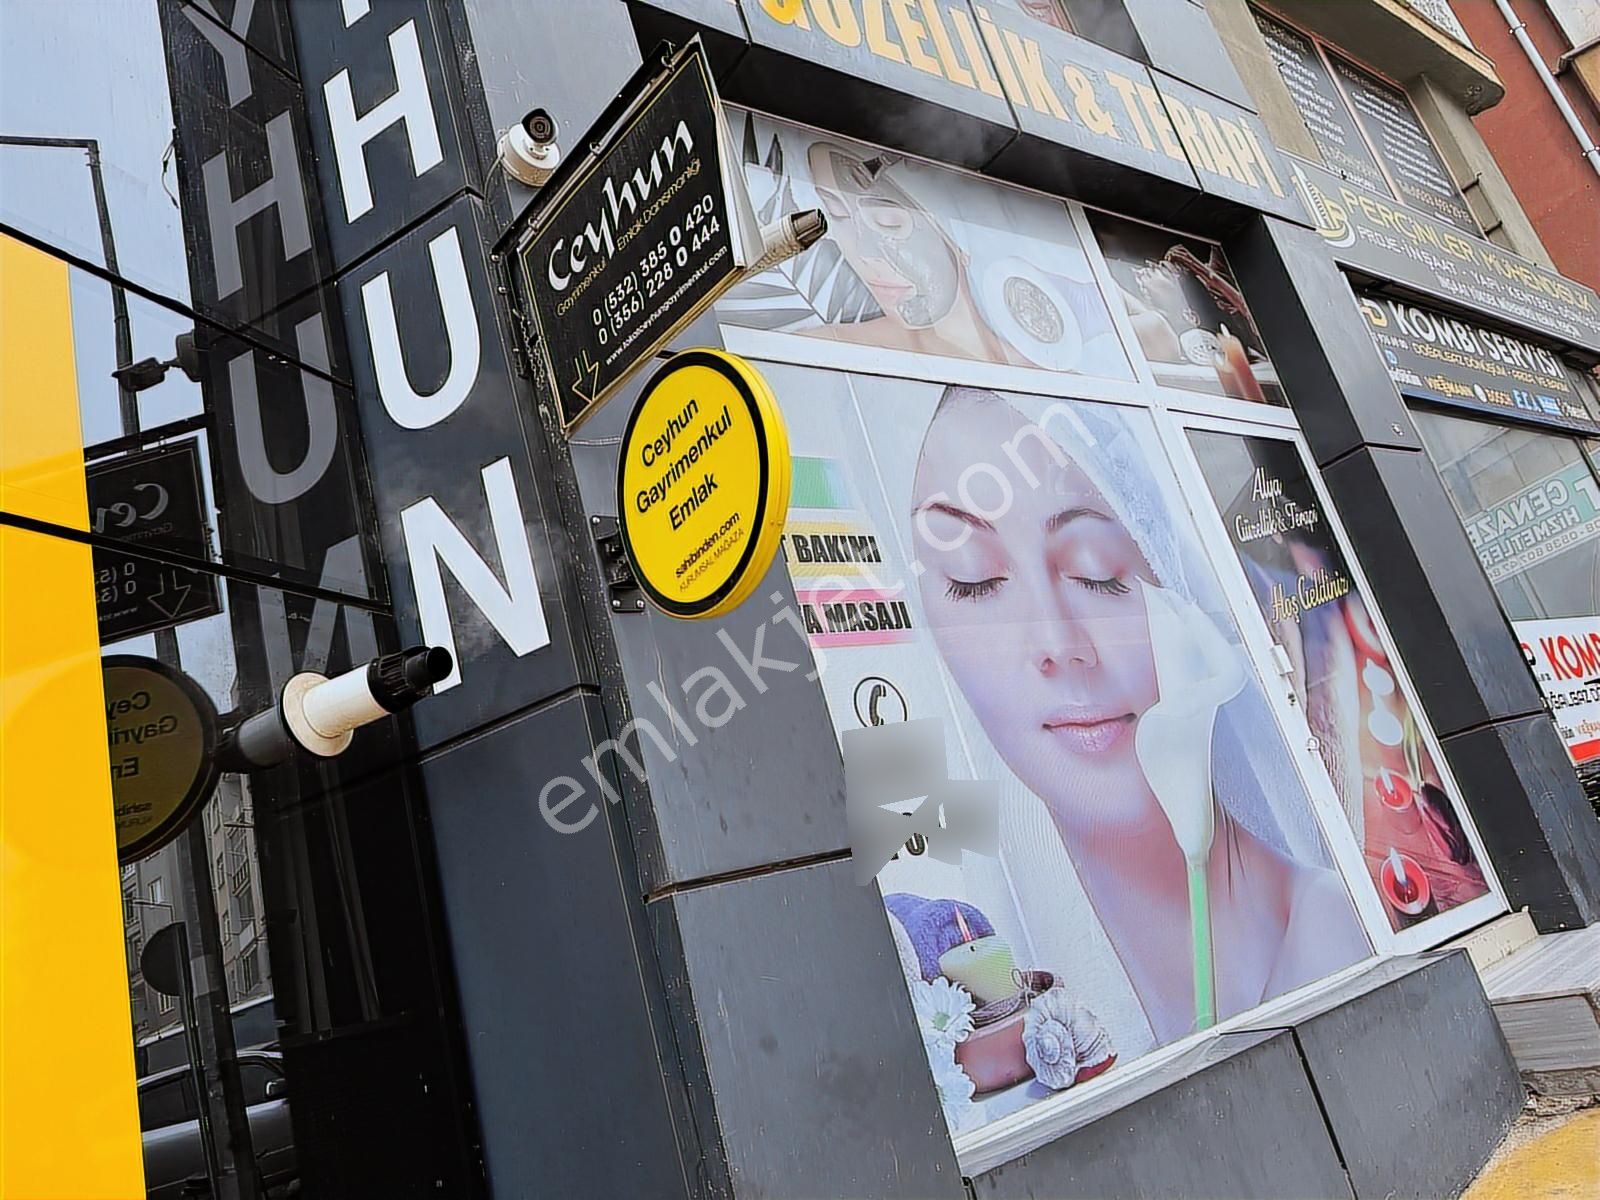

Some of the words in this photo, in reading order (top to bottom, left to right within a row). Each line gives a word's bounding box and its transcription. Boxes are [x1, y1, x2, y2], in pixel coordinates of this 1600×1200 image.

[1063, 64, 1121, 140] &
[1103, 69, 1285, 198] TERAPİ
[548, 120, 694, 292] Ceyhun
[1338, 186, 1482, 267] PERÇİNLER
[592, 308, 602, 326] 0
[604, 271, 639, 317] (532)
[639, 240, 667, 277] 385
[669, 225, 682, 247] 0
[685, 194, 714, 232] 420
[598, 328, 608, 345] 0
[610, 290, 645, 337] (356)
[646, 262, 674, 298] 228
[675, 246, 688, 267] 0
[692, 215, 720, 252] 444
[322, 0, 550, 694] HUN
[1386, 300, 1484, 357] KOMBİ
[1479, 329, 1565, 379] SERVİSİ
[636, 405, 733, 514] Gayrimenkul
[641, 398, 699, 467] Ceyhun
[668, 473, 718, 530] Emlak
[675, 511, 740, 578] sahibinden.com
[791, 534, 882, 563] BAKIMI
[822, 601, 912, 633] MASAJI
